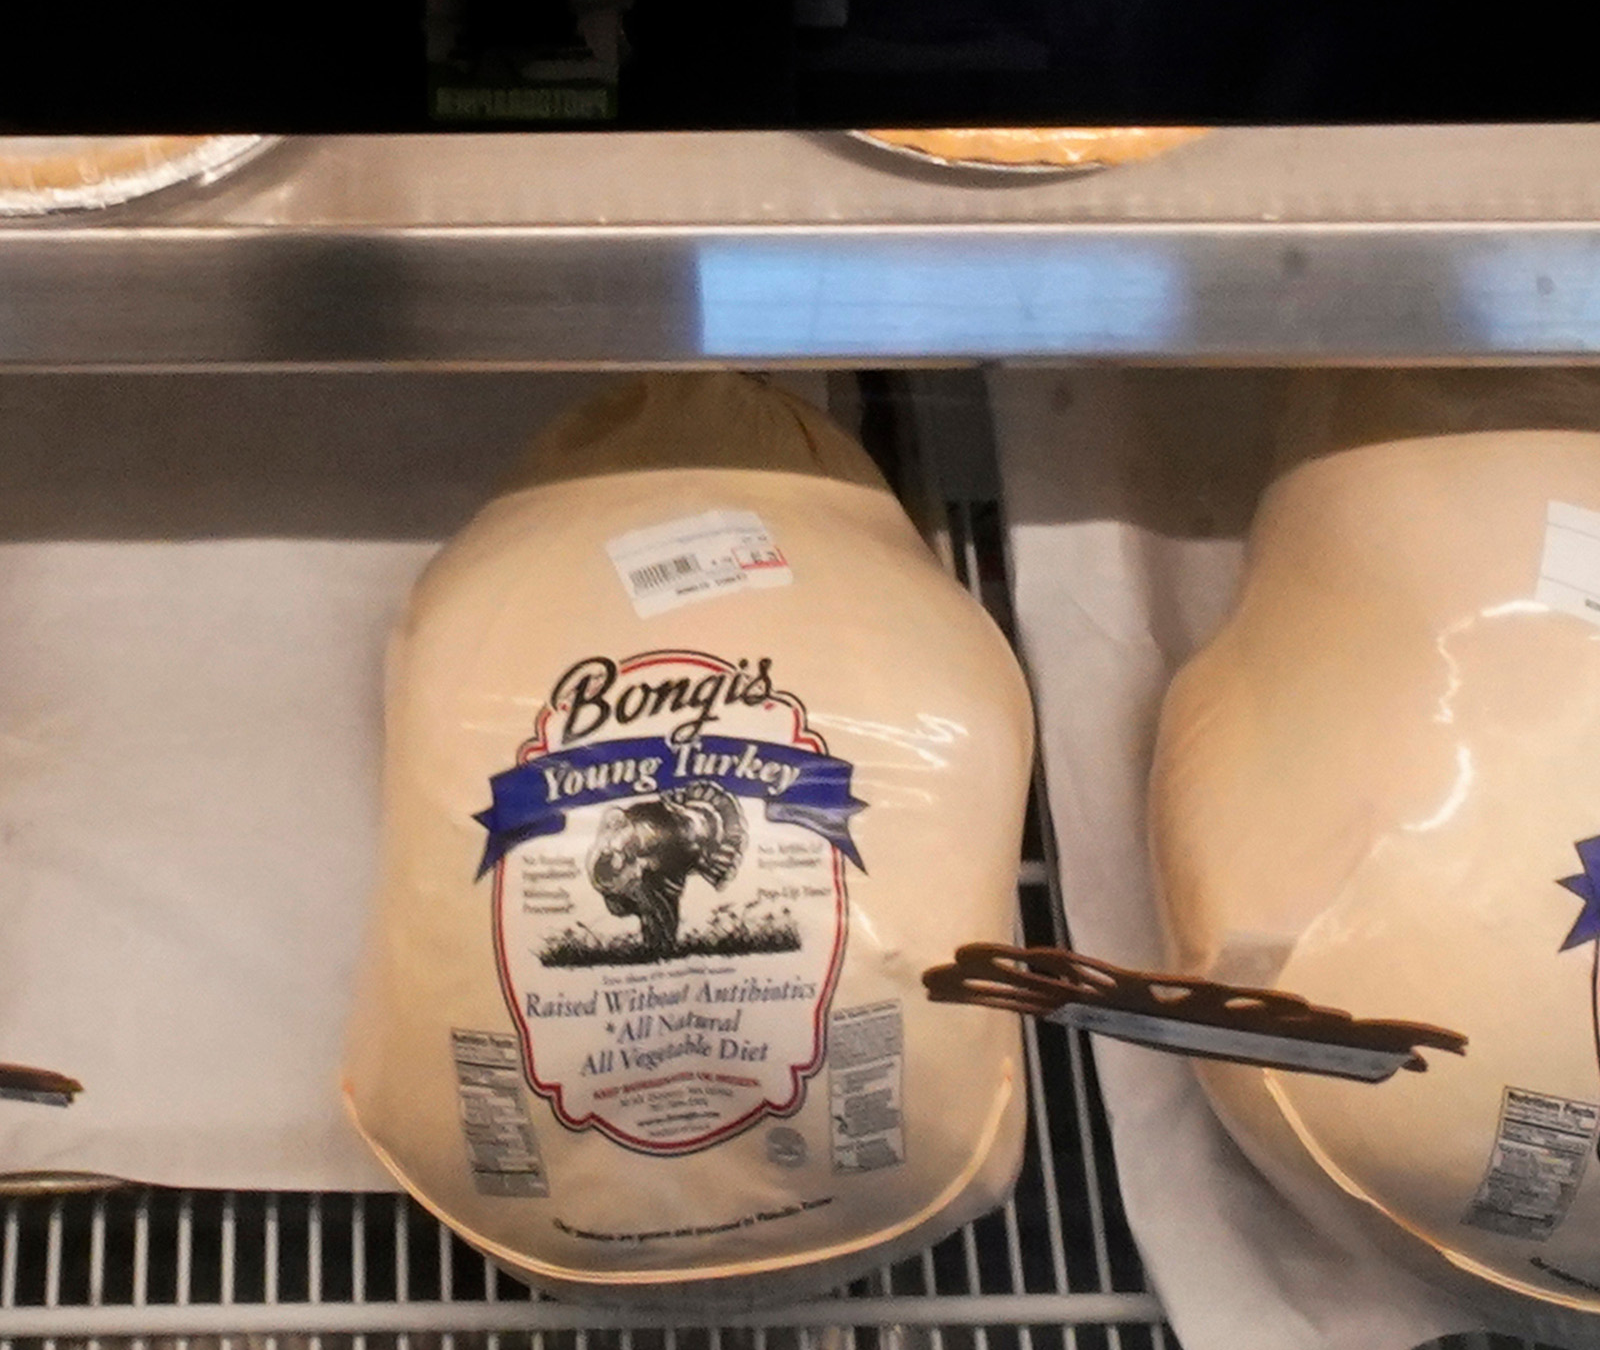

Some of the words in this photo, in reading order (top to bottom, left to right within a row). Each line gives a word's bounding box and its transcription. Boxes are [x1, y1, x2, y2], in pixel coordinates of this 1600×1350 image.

[543, 754, 663, 803] Young
[672, 744, 802, 796] Turkey
[526, 988, 598, 1017] Raised
[605, 982, 691, 1013] Without
[658, 1009, 742, 1032] Natural
[581, 1050, 613, 1077] All
[719, 1038, 768, 1062] Diet
